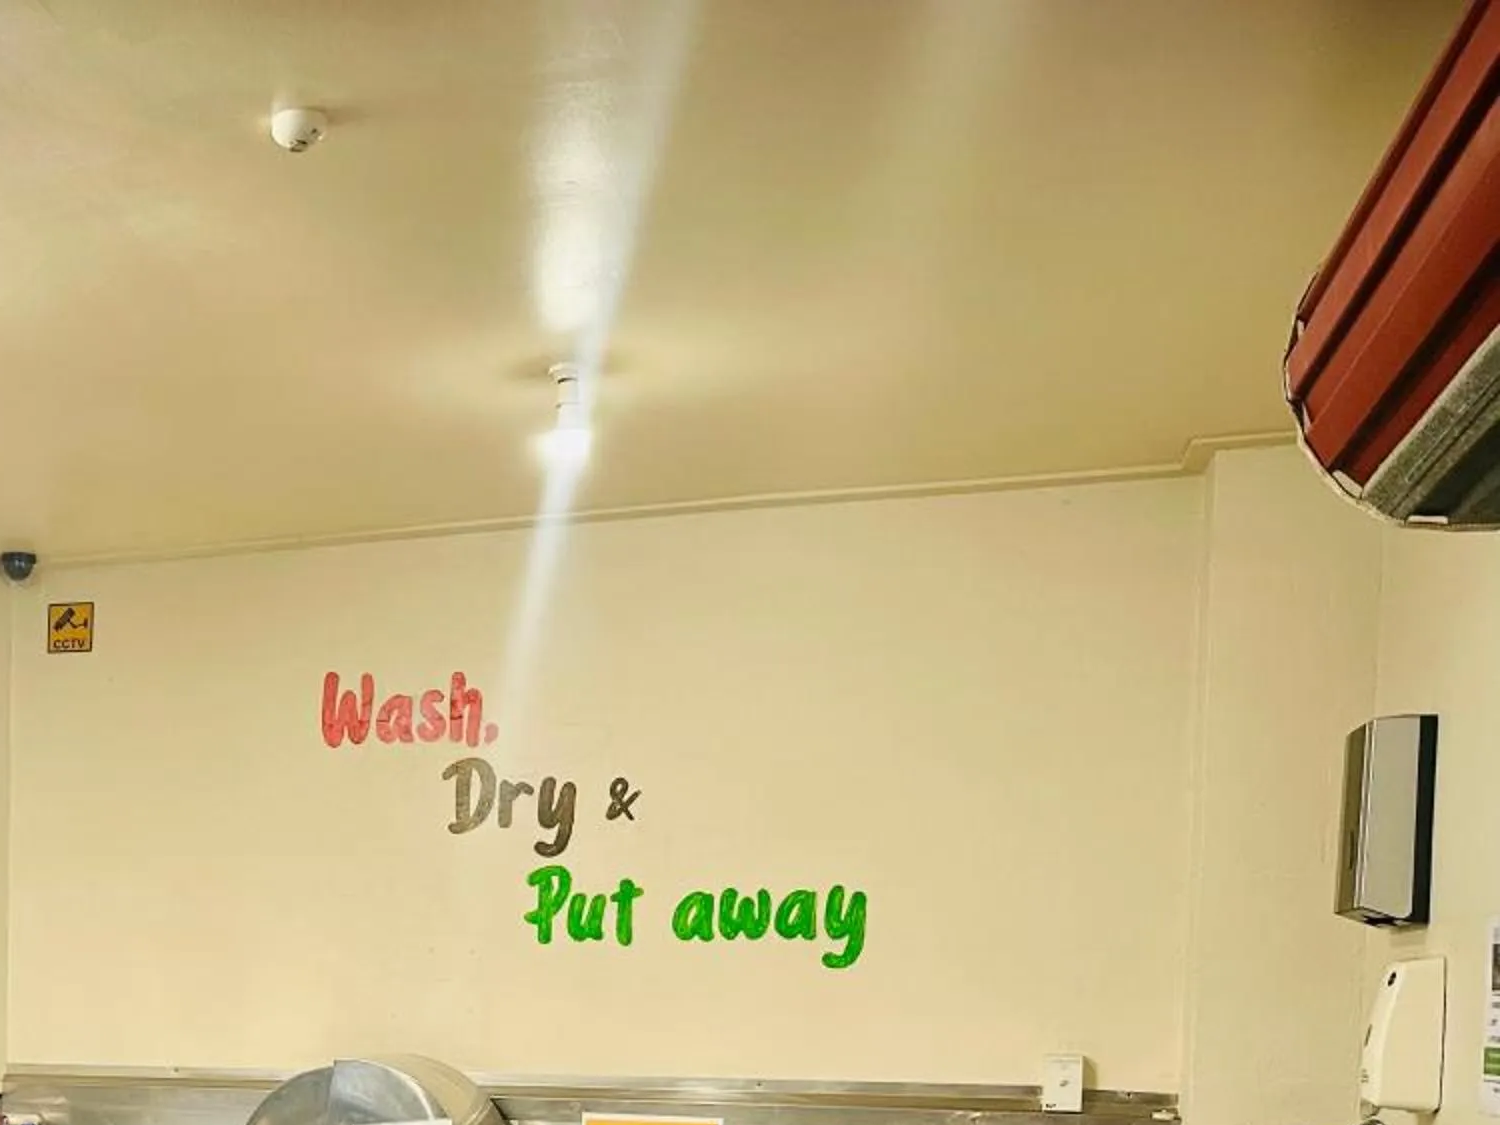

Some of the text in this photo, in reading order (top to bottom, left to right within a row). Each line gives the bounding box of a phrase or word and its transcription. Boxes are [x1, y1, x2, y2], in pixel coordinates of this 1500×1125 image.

[53, 639, 85, 649] CCTV
[321, 671, 498, 748] Wash,
[442, 757, 642, 857] Dry &
[523, 865, 867, 968] Put away
